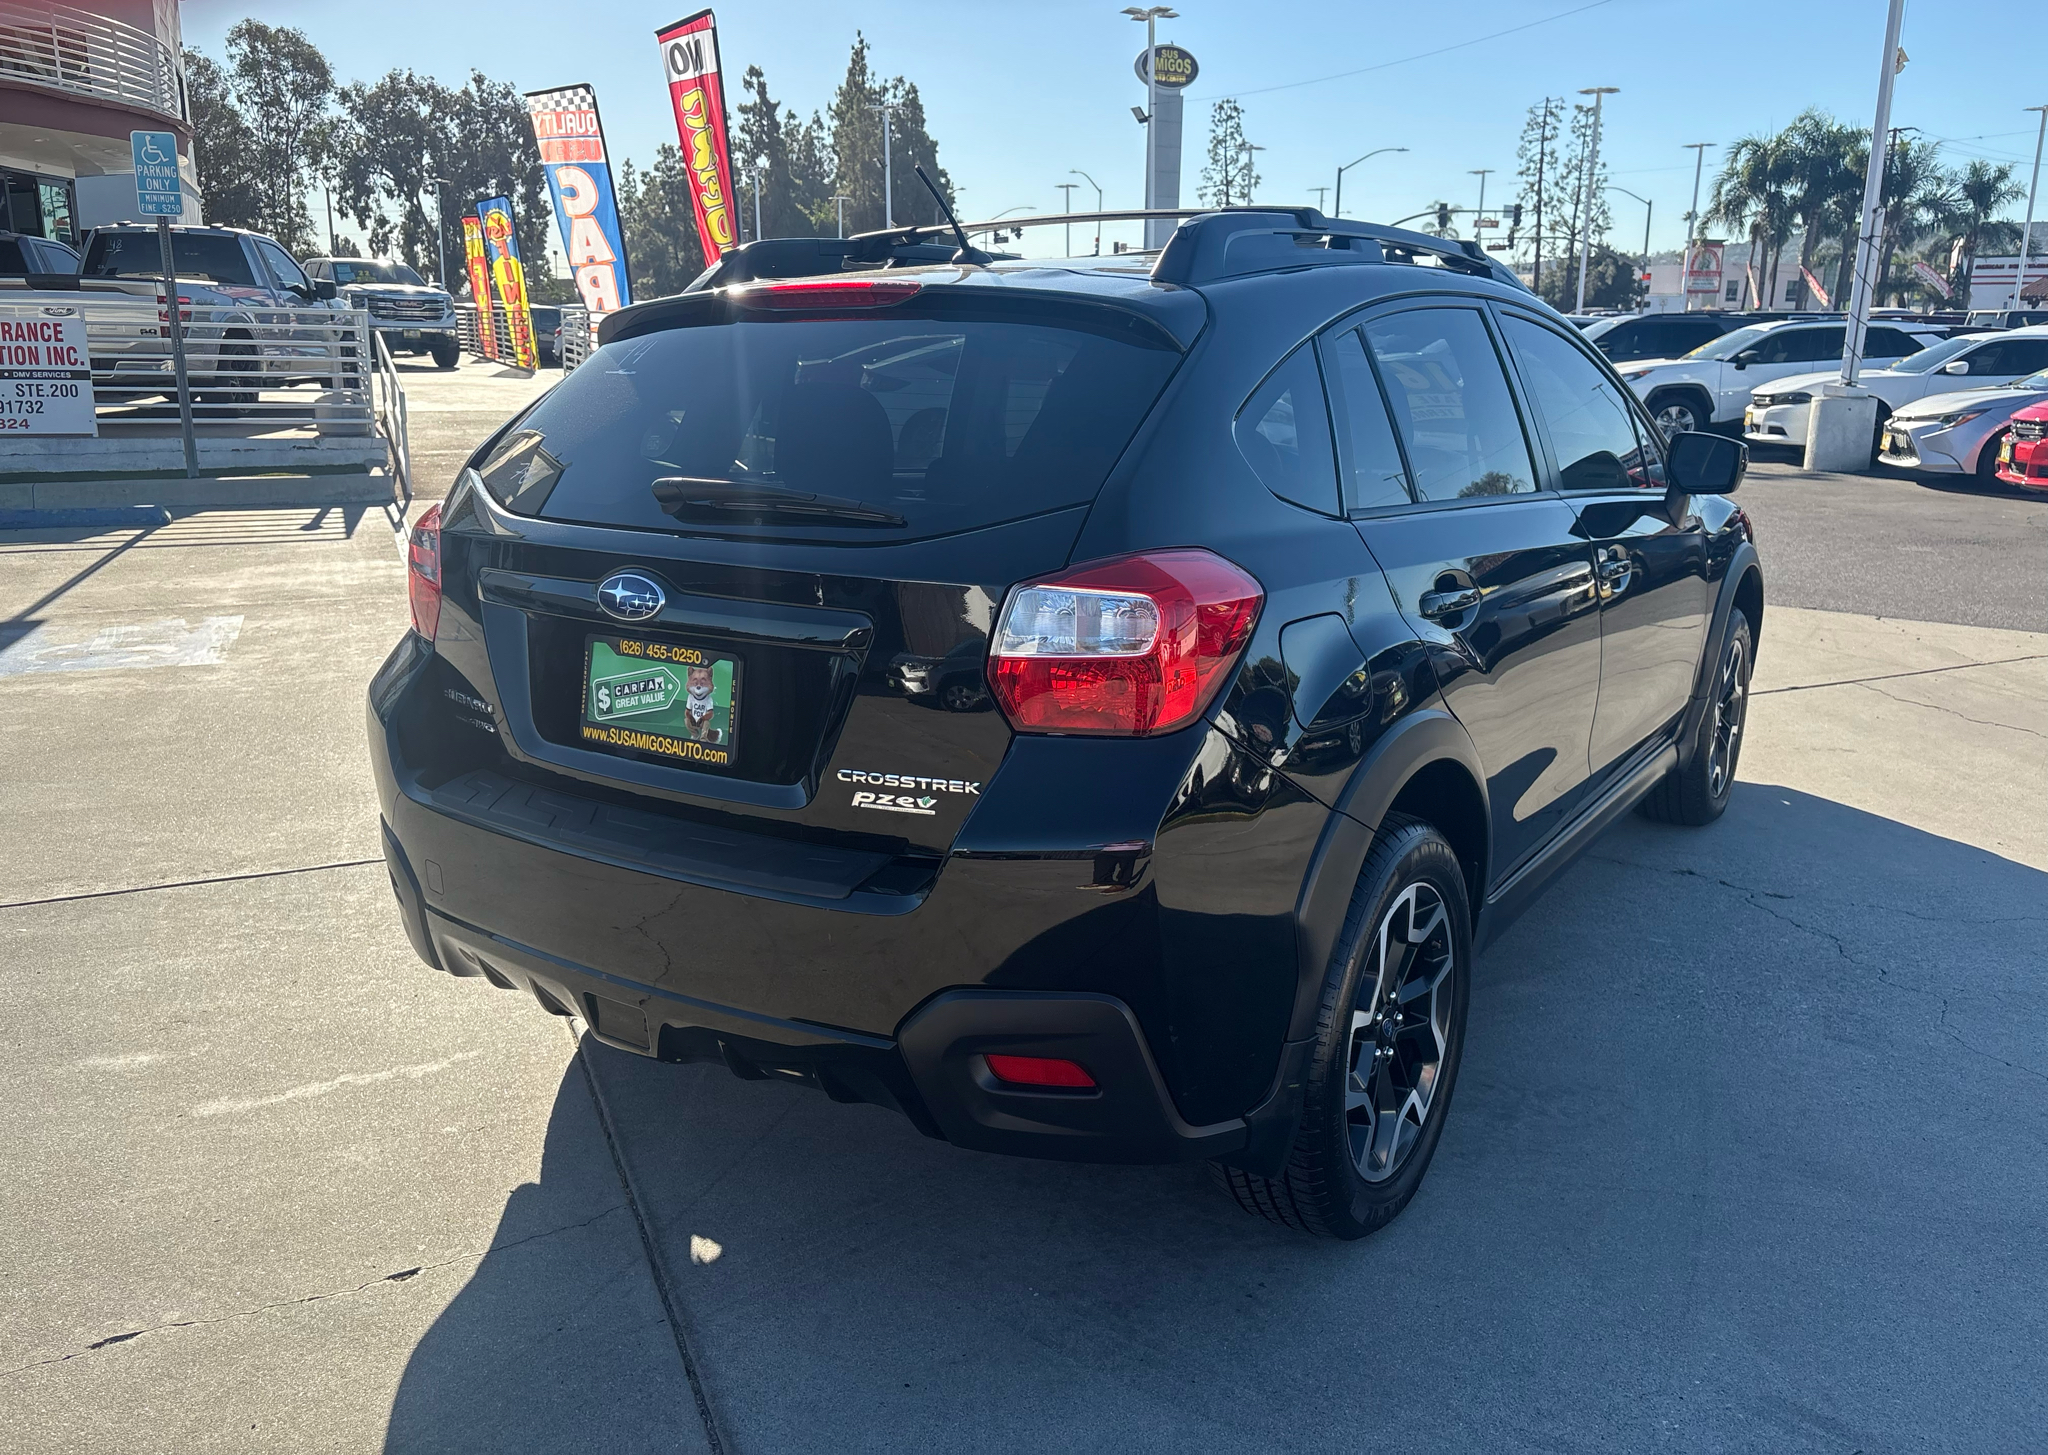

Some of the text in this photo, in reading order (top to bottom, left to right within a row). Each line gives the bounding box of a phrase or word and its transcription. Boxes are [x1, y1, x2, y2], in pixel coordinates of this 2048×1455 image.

[1161, 49, 1179, 60] SUS
[1146, 57, 1192, 75] MIGOS
[136, 164, 177, 178] PARKING
[146, 178, 170, 191] ONLY
[145, 194, 175, 203] MINIMUM
[141, 203, 181, 213] FINE $250
[0, 322, 64, 342] RANCE
[0, 345, 85, 366] TION INC.
[32, 371, 72, 379] SERVICES
[15, 383, 79, 398] STE.200
[619, 639, 702, 664] (626) 455-0250
[615, 677, 664, 697] CARFAX
[615, 692, 666, 709] GREAT VALUE
[693, 702, 706, 712] CAR
[693, 709, 705, 718] FOX
[583, 726, 728, 764] www.SUSAMIGOSAUTO.com
[836, 769, 981, 795] CROSSTREK
